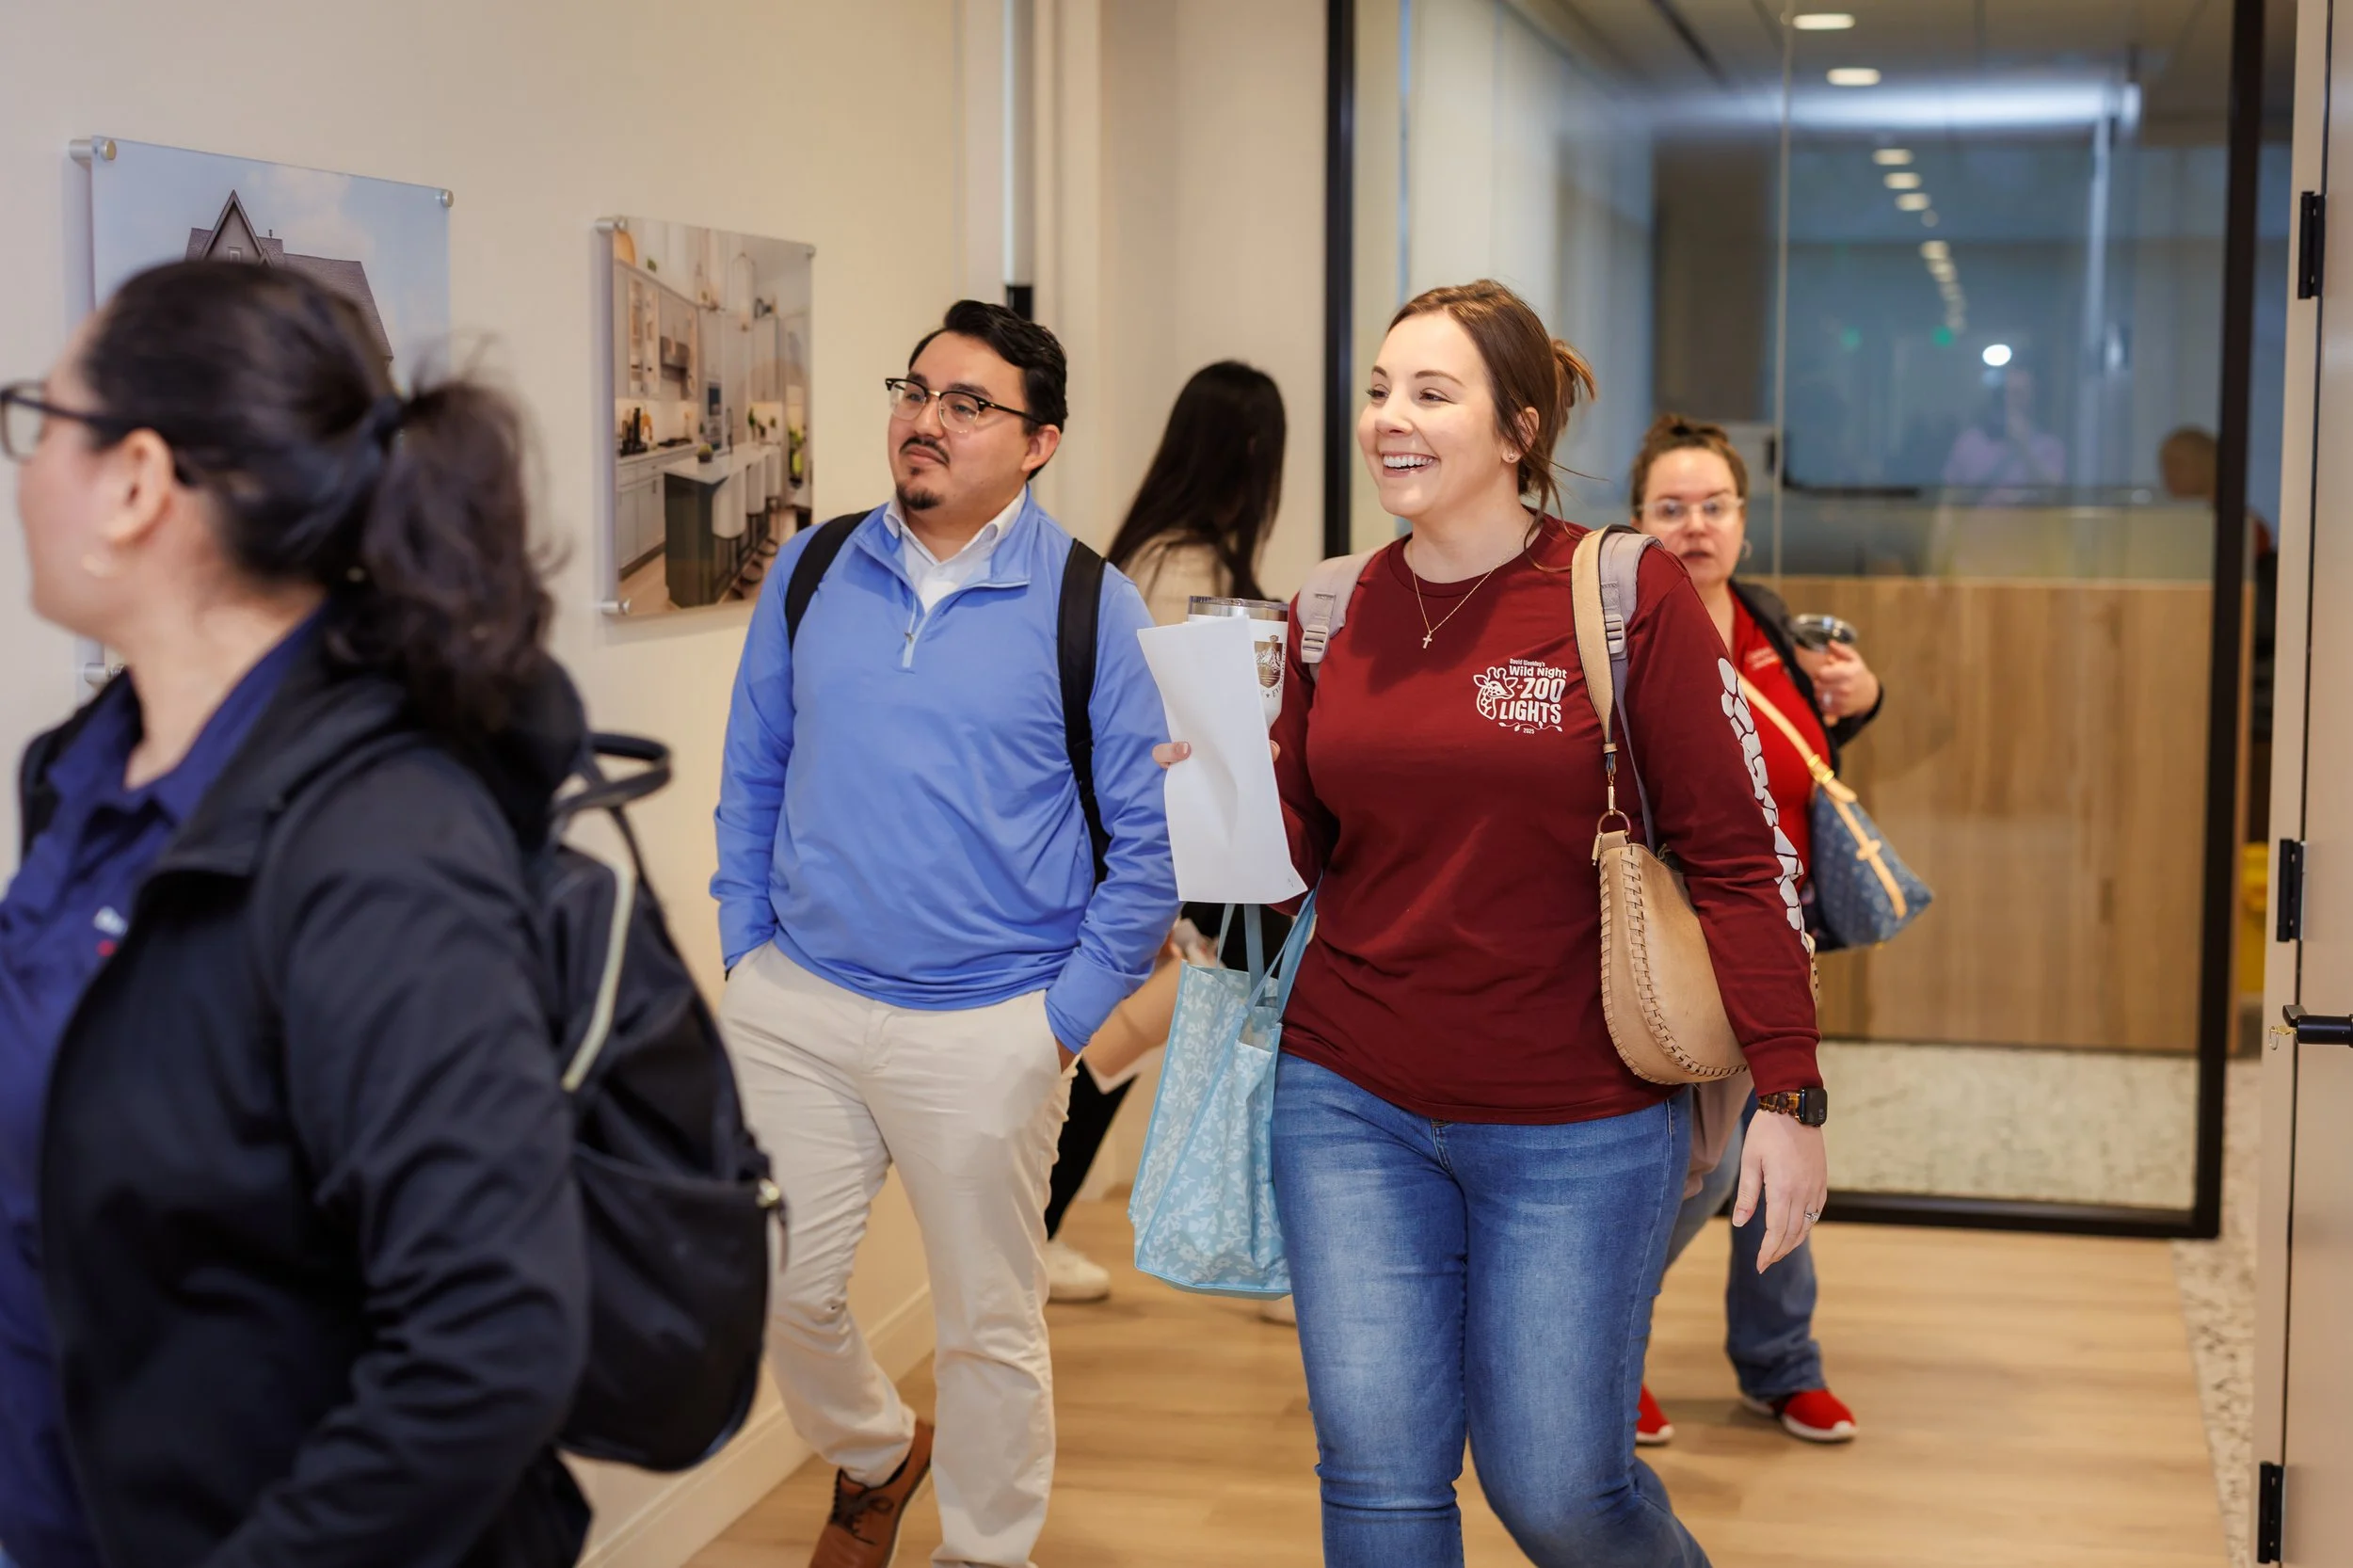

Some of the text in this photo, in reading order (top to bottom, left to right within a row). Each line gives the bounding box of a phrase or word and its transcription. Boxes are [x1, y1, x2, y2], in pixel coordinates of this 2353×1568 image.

[1509, 665, 1567, 679] Wild Night
[1520, 677, 1566, 703] ZOO
[1499, 700, 1562, 724] LIGHTS
